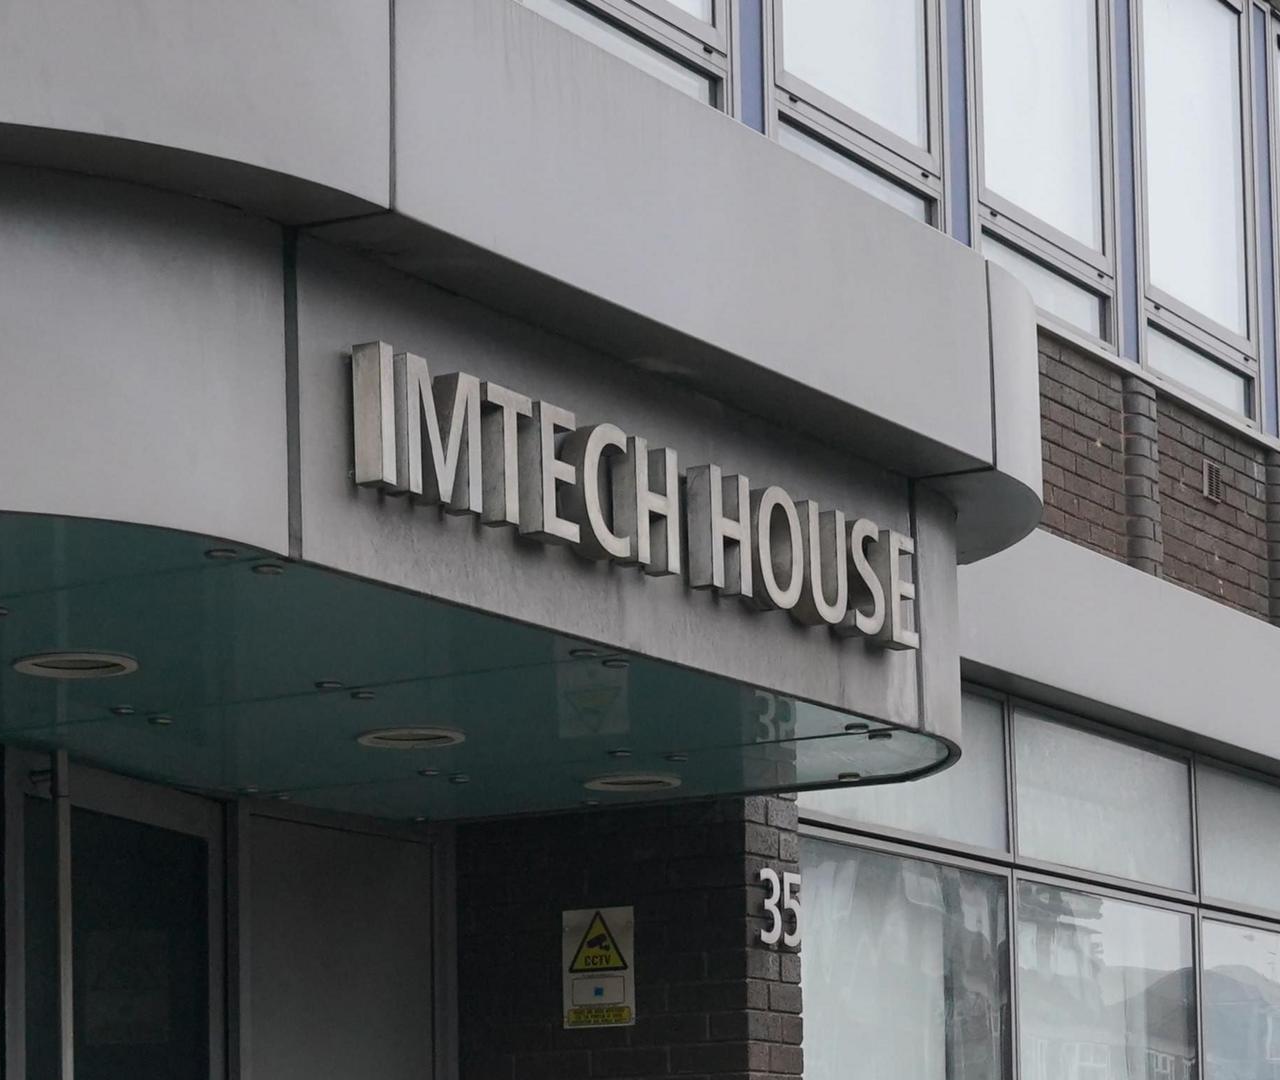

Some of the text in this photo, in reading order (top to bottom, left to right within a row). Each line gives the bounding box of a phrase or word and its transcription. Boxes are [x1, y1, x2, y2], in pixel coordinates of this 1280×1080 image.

[351, 340, 919, 652] IMTECH HOUSE
[760, 867, 801, 947] 35
[584, 955, 611, 966] CCTV
